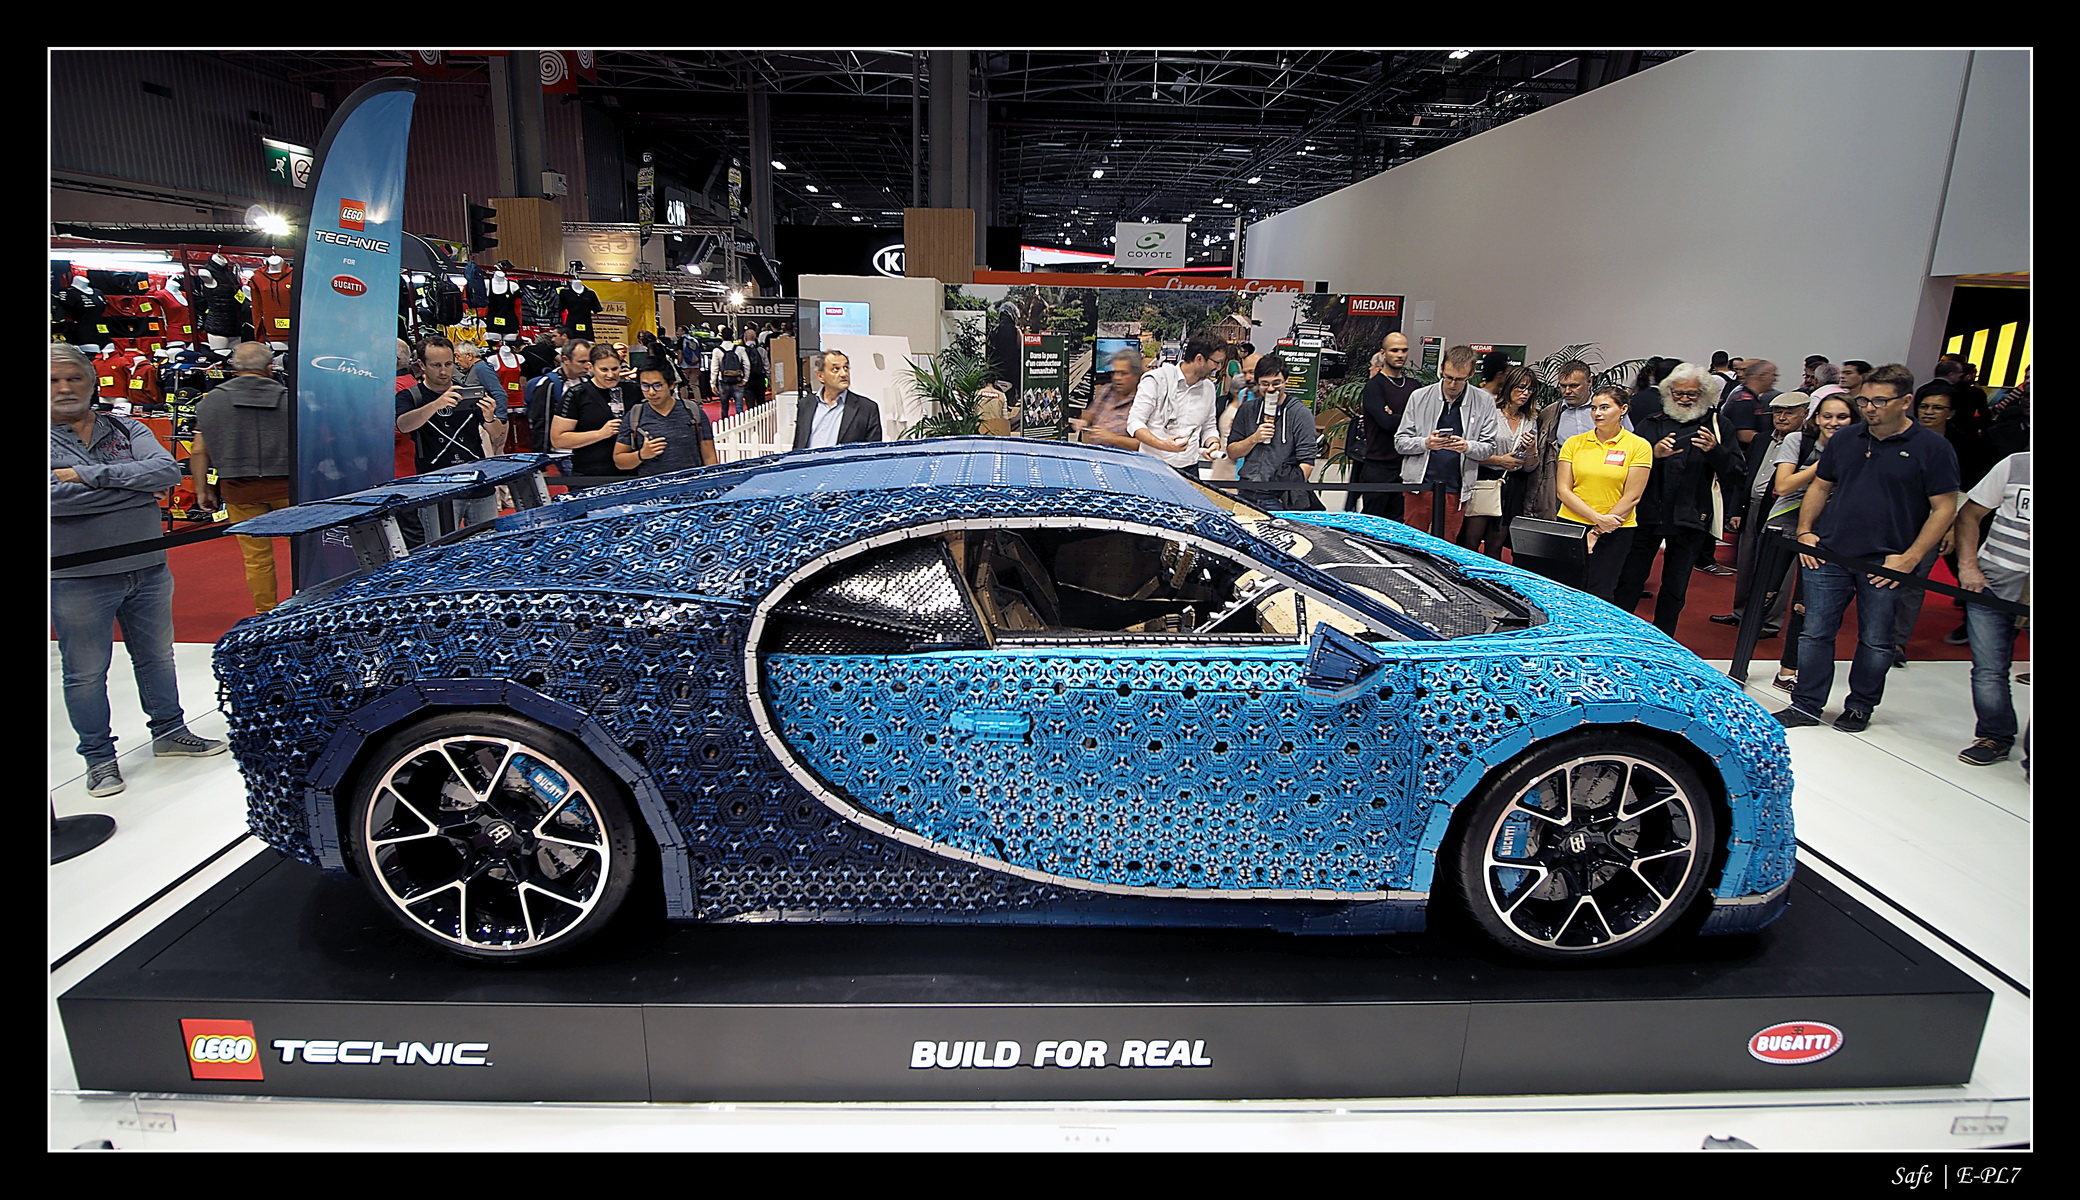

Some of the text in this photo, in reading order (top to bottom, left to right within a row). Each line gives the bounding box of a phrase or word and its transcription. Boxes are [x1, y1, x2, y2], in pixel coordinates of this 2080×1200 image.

[342, 208, 363, 221] LEGO
[315, 230, 390, 254] TECHNIC
[1127, 251, 1172, 259] COYOTE
[342, 258, 356, 266] FOR
[333, 279, 362, 292] BUGATTI
[1352, 299, 1396, 311] MEDAIR
[1025, 335, 1041, 343] MEDAIR
[1756, 1034, 1832, 1052] BUGATTI
[195, 1038, 490, 1065] LEGO TECHNIC
[910, 1040, 1212, 1068] BUILD FOR REAL
